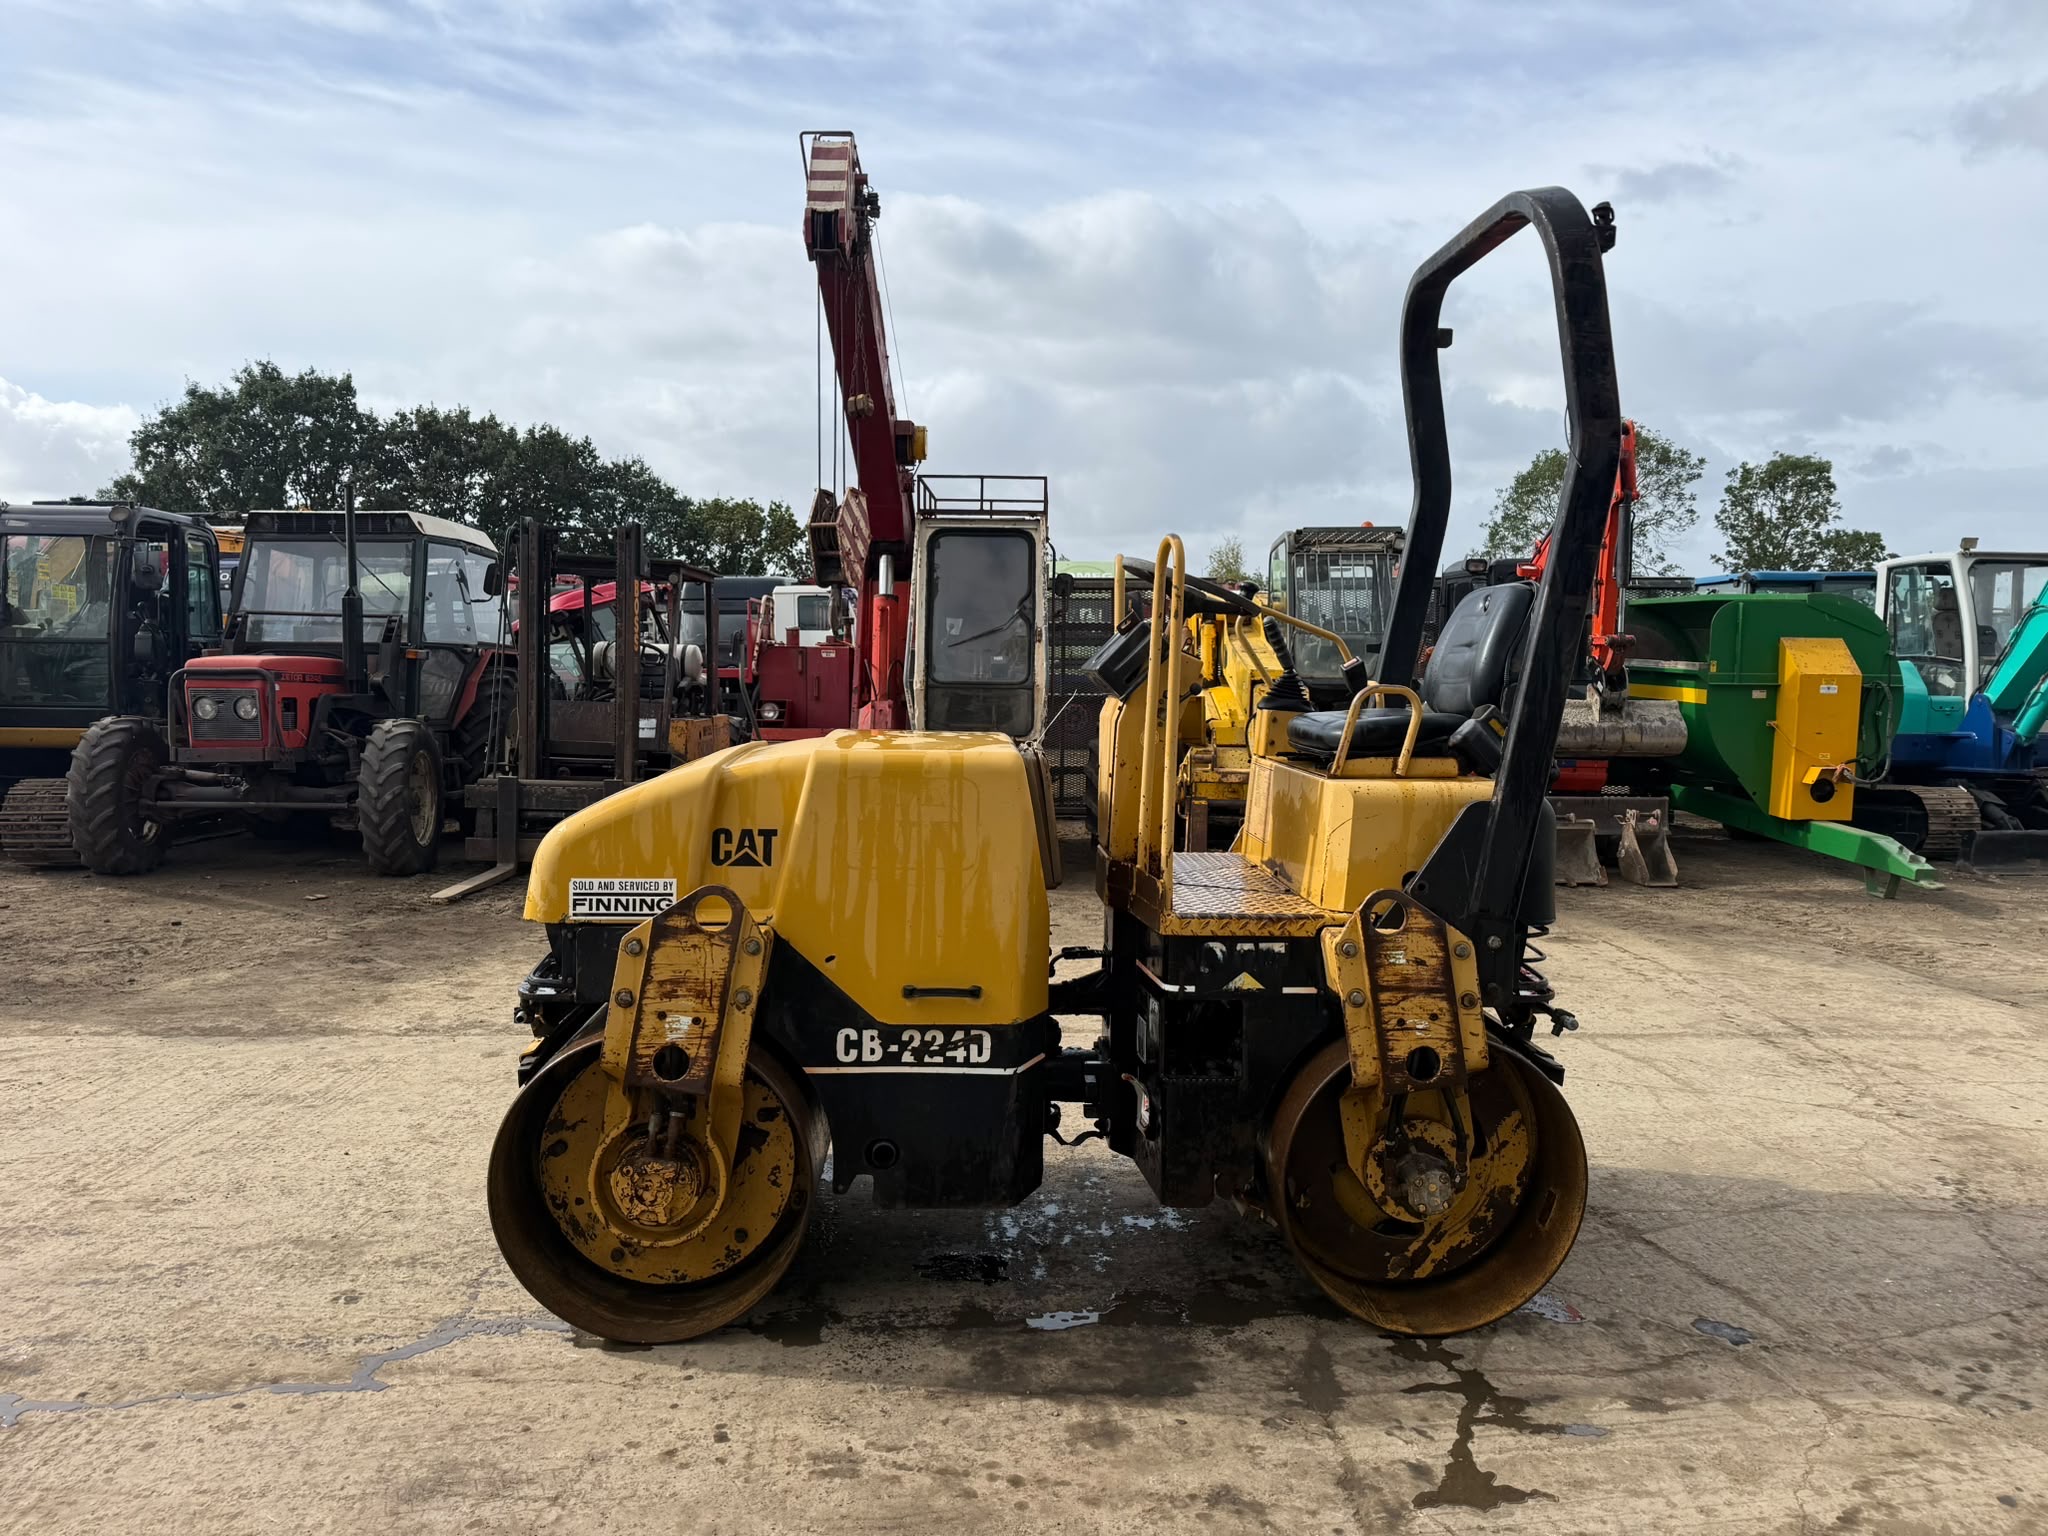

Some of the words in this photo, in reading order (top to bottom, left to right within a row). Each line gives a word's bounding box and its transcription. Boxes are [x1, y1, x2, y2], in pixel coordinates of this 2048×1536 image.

[711, 827, 778, 867] CAT
[572, 881, 594, 891] SOLD
[597, 881, 615, 891] AND
[618, 881, 660, 891] SERVICED
[663, 881, 674, 891] BY
[572, 897, 674, 913] FINNING
[836, 1027, 992, 1063] CB-224D
